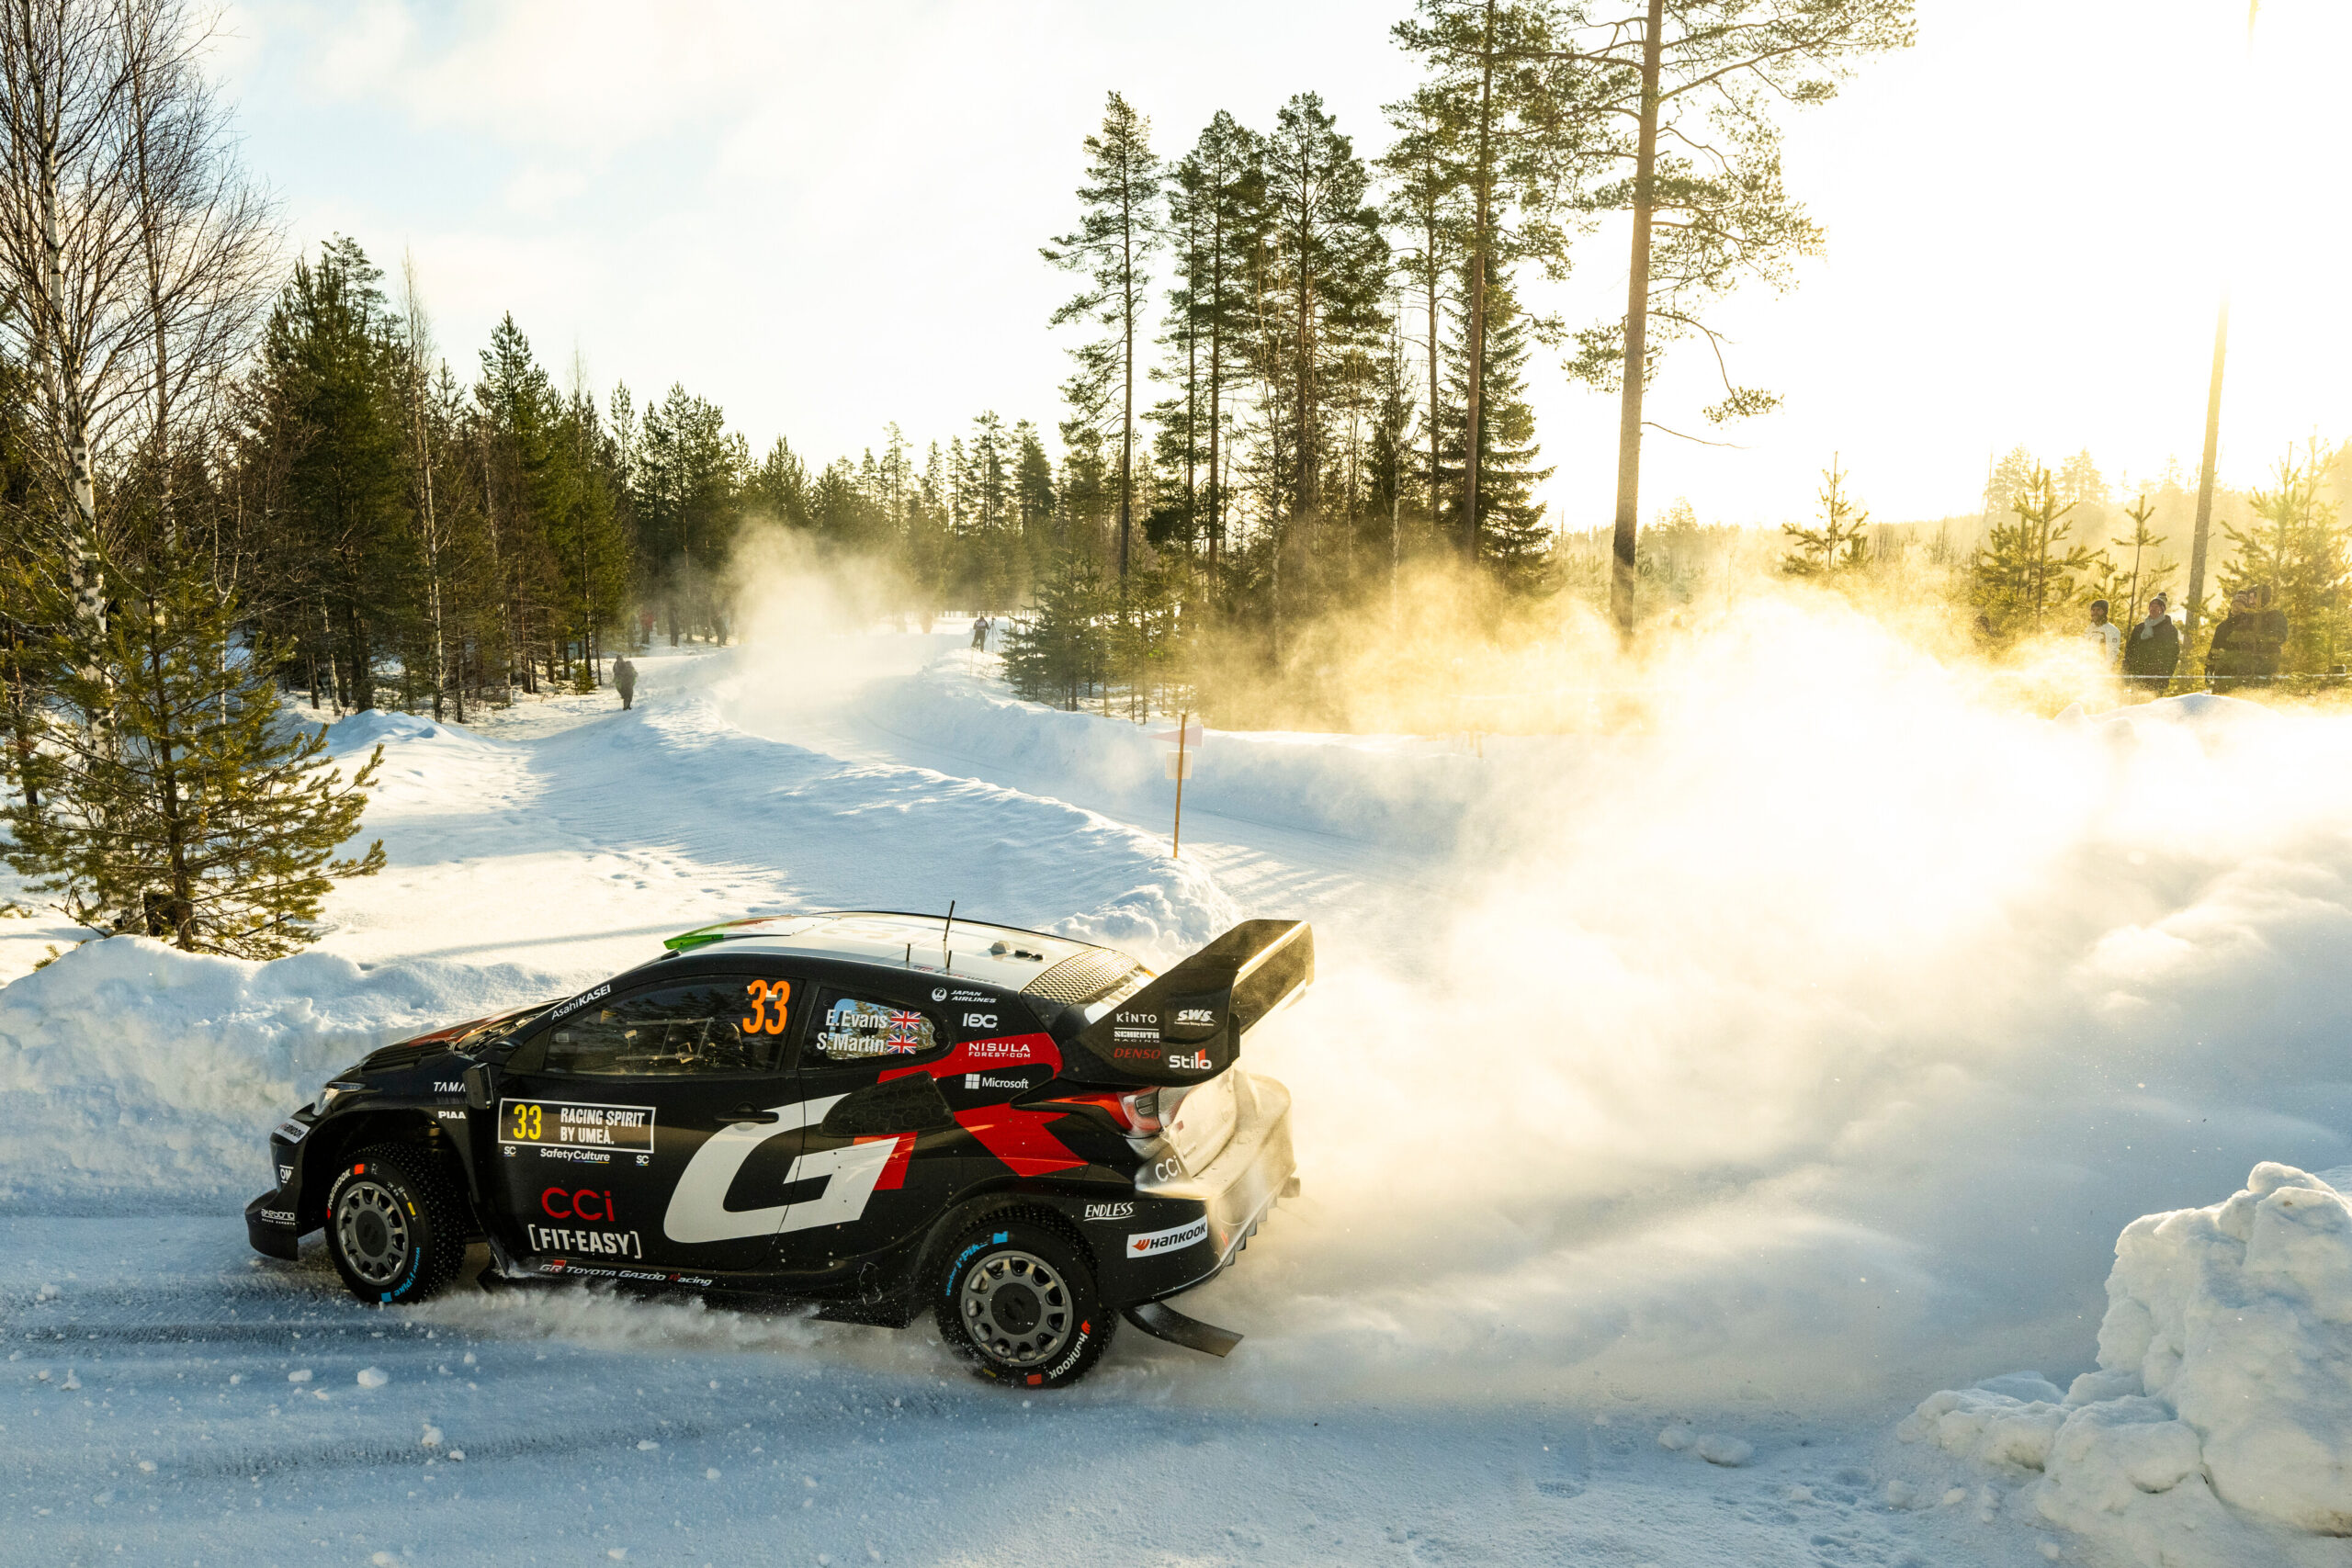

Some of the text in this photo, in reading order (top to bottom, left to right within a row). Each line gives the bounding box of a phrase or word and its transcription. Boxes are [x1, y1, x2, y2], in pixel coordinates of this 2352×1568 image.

[551, 984, 611, 1021] AsahiKASEI
[742, 979, 791, 1035] 33
[1176, 1009, 1215, 1022] SWS
[968, 1043, 1031, 1053] NISULA
[1114, 1047, 1161, 1059] DENSO
[1169, 1051, 1213, 1070] Stilo
[982, 1077, 1029, 1089] Microsoft
[437, 1111, 467, 1120] PIAA
[513, 1104, 542, 1140] 33
[560, 1108, 646, 1128] RACING SPIRIT
[560, 1127, 574, 1142] BY
[503, 1146, 516, 1155] SC
[540, 1148, 610, 1162] SafetyCulture
[636, 1155, 650, 1164] SC
[1084, 1201, 1135, 1218] ENDLESS
[539, 1264, 713, 1286] GR TOYOTA GAZOO Racing
